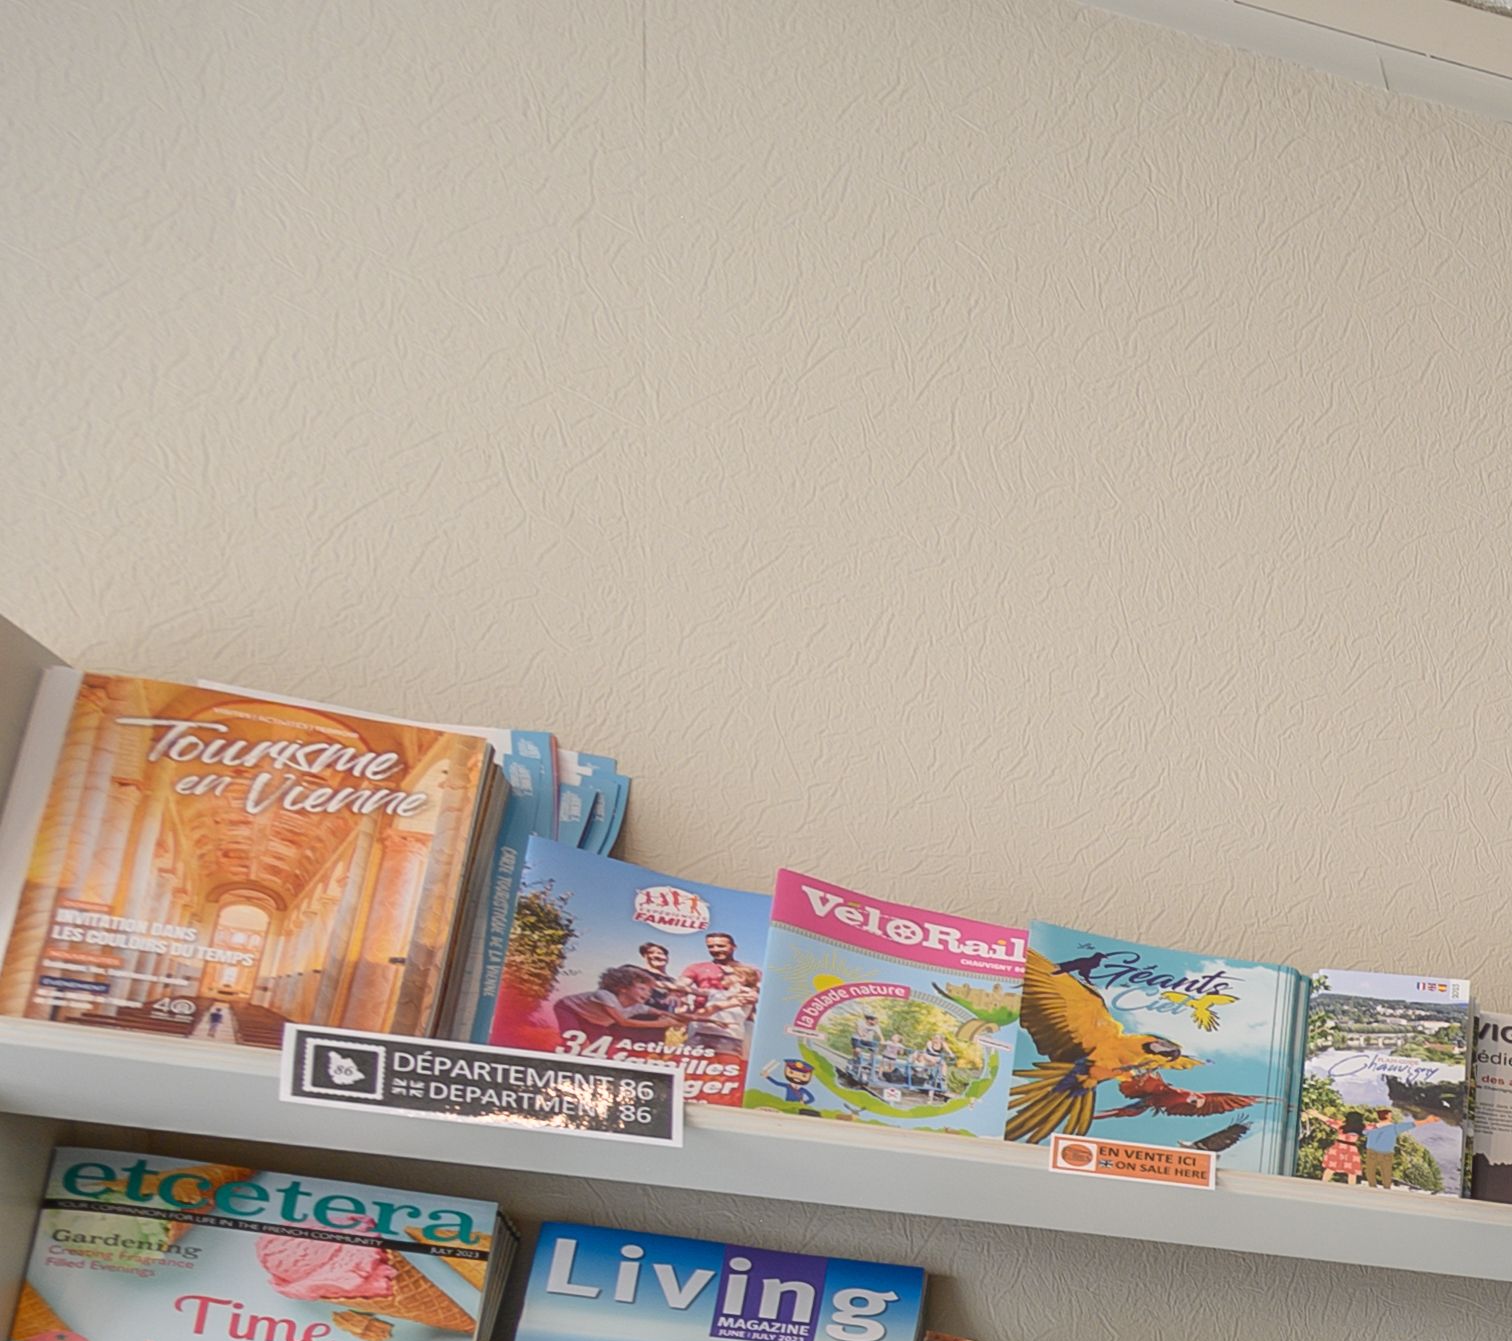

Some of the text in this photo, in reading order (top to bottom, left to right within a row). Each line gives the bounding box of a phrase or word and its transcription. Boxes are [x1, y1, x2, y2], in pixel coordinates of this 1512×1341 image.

[117, 717, 401, 782] Tourisme
[175, 769, 429, 819] en Vienne
[634, 911, 709, 930] FAMILLE
[616, 1038, 715, 1057] Activités
[391, 1050, 655, 1101] DÉPARTEMENT 86
[1328, 1054, 1440, 1082] Chauvigny
[429, 1080, 652, 1125] DEPARTMENT 86
[1099, 1145, 1197, 1166] EN VENTE ICI
[1116, 1159, 1208, 1180] ON SALE HERE
[62, 1159, 481, 1246] etcetera
[53, 1230, 202, 1260] Gardening
[717, 1316, 809, 1337] MAGAZINE
